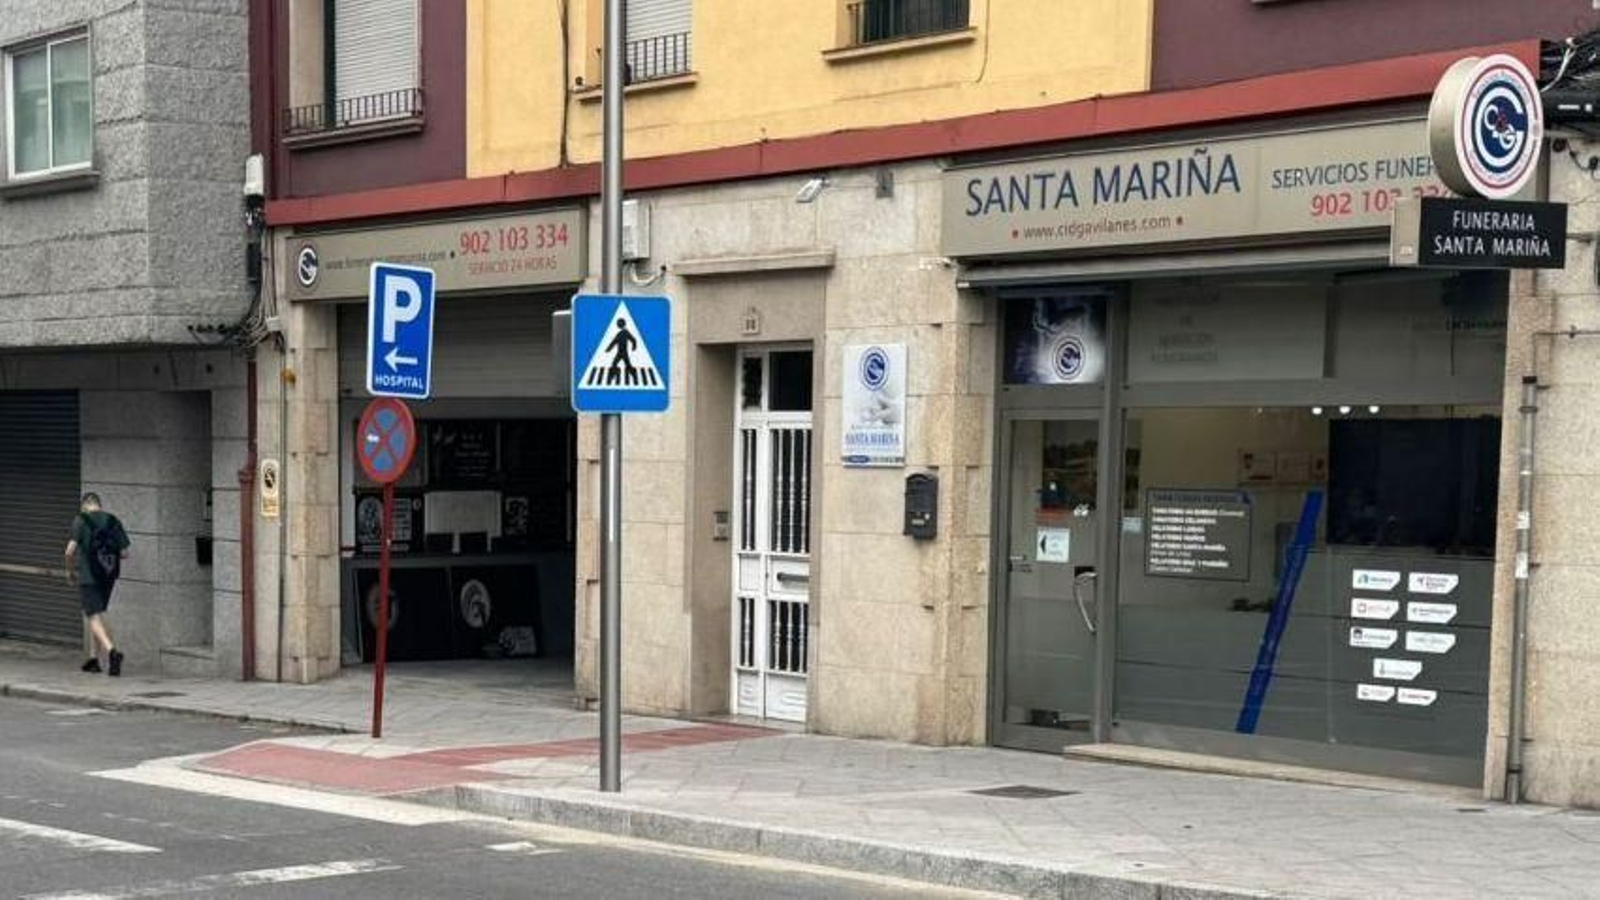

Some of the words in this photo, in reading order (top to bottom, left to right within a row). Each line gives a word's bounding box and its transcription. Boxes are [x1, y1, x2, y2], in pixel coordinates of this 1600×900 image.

[966, 169, 1079, 216] SANTA
[1092, 148, 1241, 206] MARIÑA
[1272, 162, 1369, 189] SERVICIOS
[1311, 192, 1352, 217] 902
[1023, 215, 1172, 240] www.cidgavilanes.com
[1452, 210, 1535, 231] FUNERARIA
[460, 230, 490, 256] 902
[498, 226, 528, 251] 103
[535, 222, 568, 249] 334
[1433, 234, 1485, 256] SANTA
[1493, 235, 1551, 257] MARIÑA
[525, 255, 557, 271] HORAS
[382, 274, 422, 343] P
[375, 375, 424, 390] HOSPITAL
